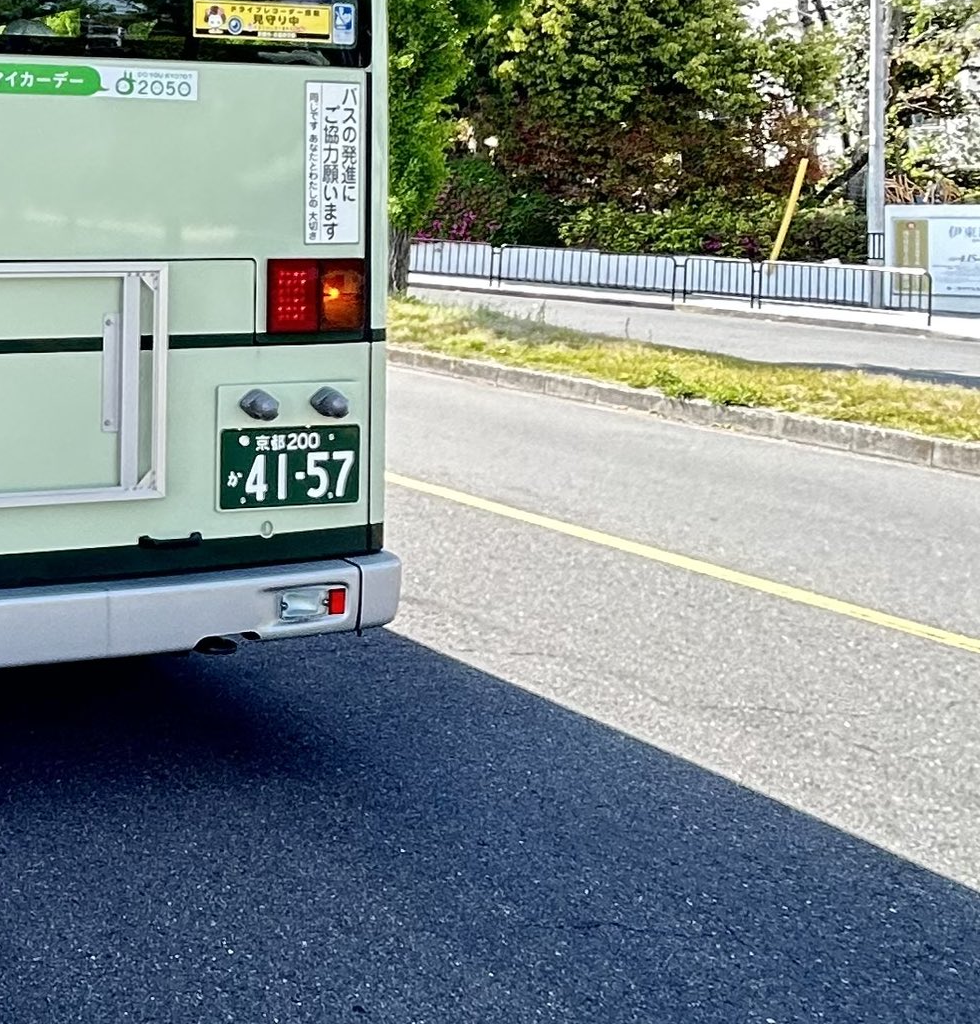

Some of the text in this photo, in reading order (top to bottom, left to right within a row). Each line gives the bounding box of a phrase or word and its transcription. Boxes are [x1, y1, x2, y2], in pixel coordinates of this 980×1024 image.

[253, 14, 300, 26] 見守り中
[137, 79, 192, 98] 2050
[341, 87, 358, 202] バスの発進に
[322, 105, 340, 241] ご協力願います
[255, 433, 320, 451] 京都200
[245, 450, 355, 502] 41-57
